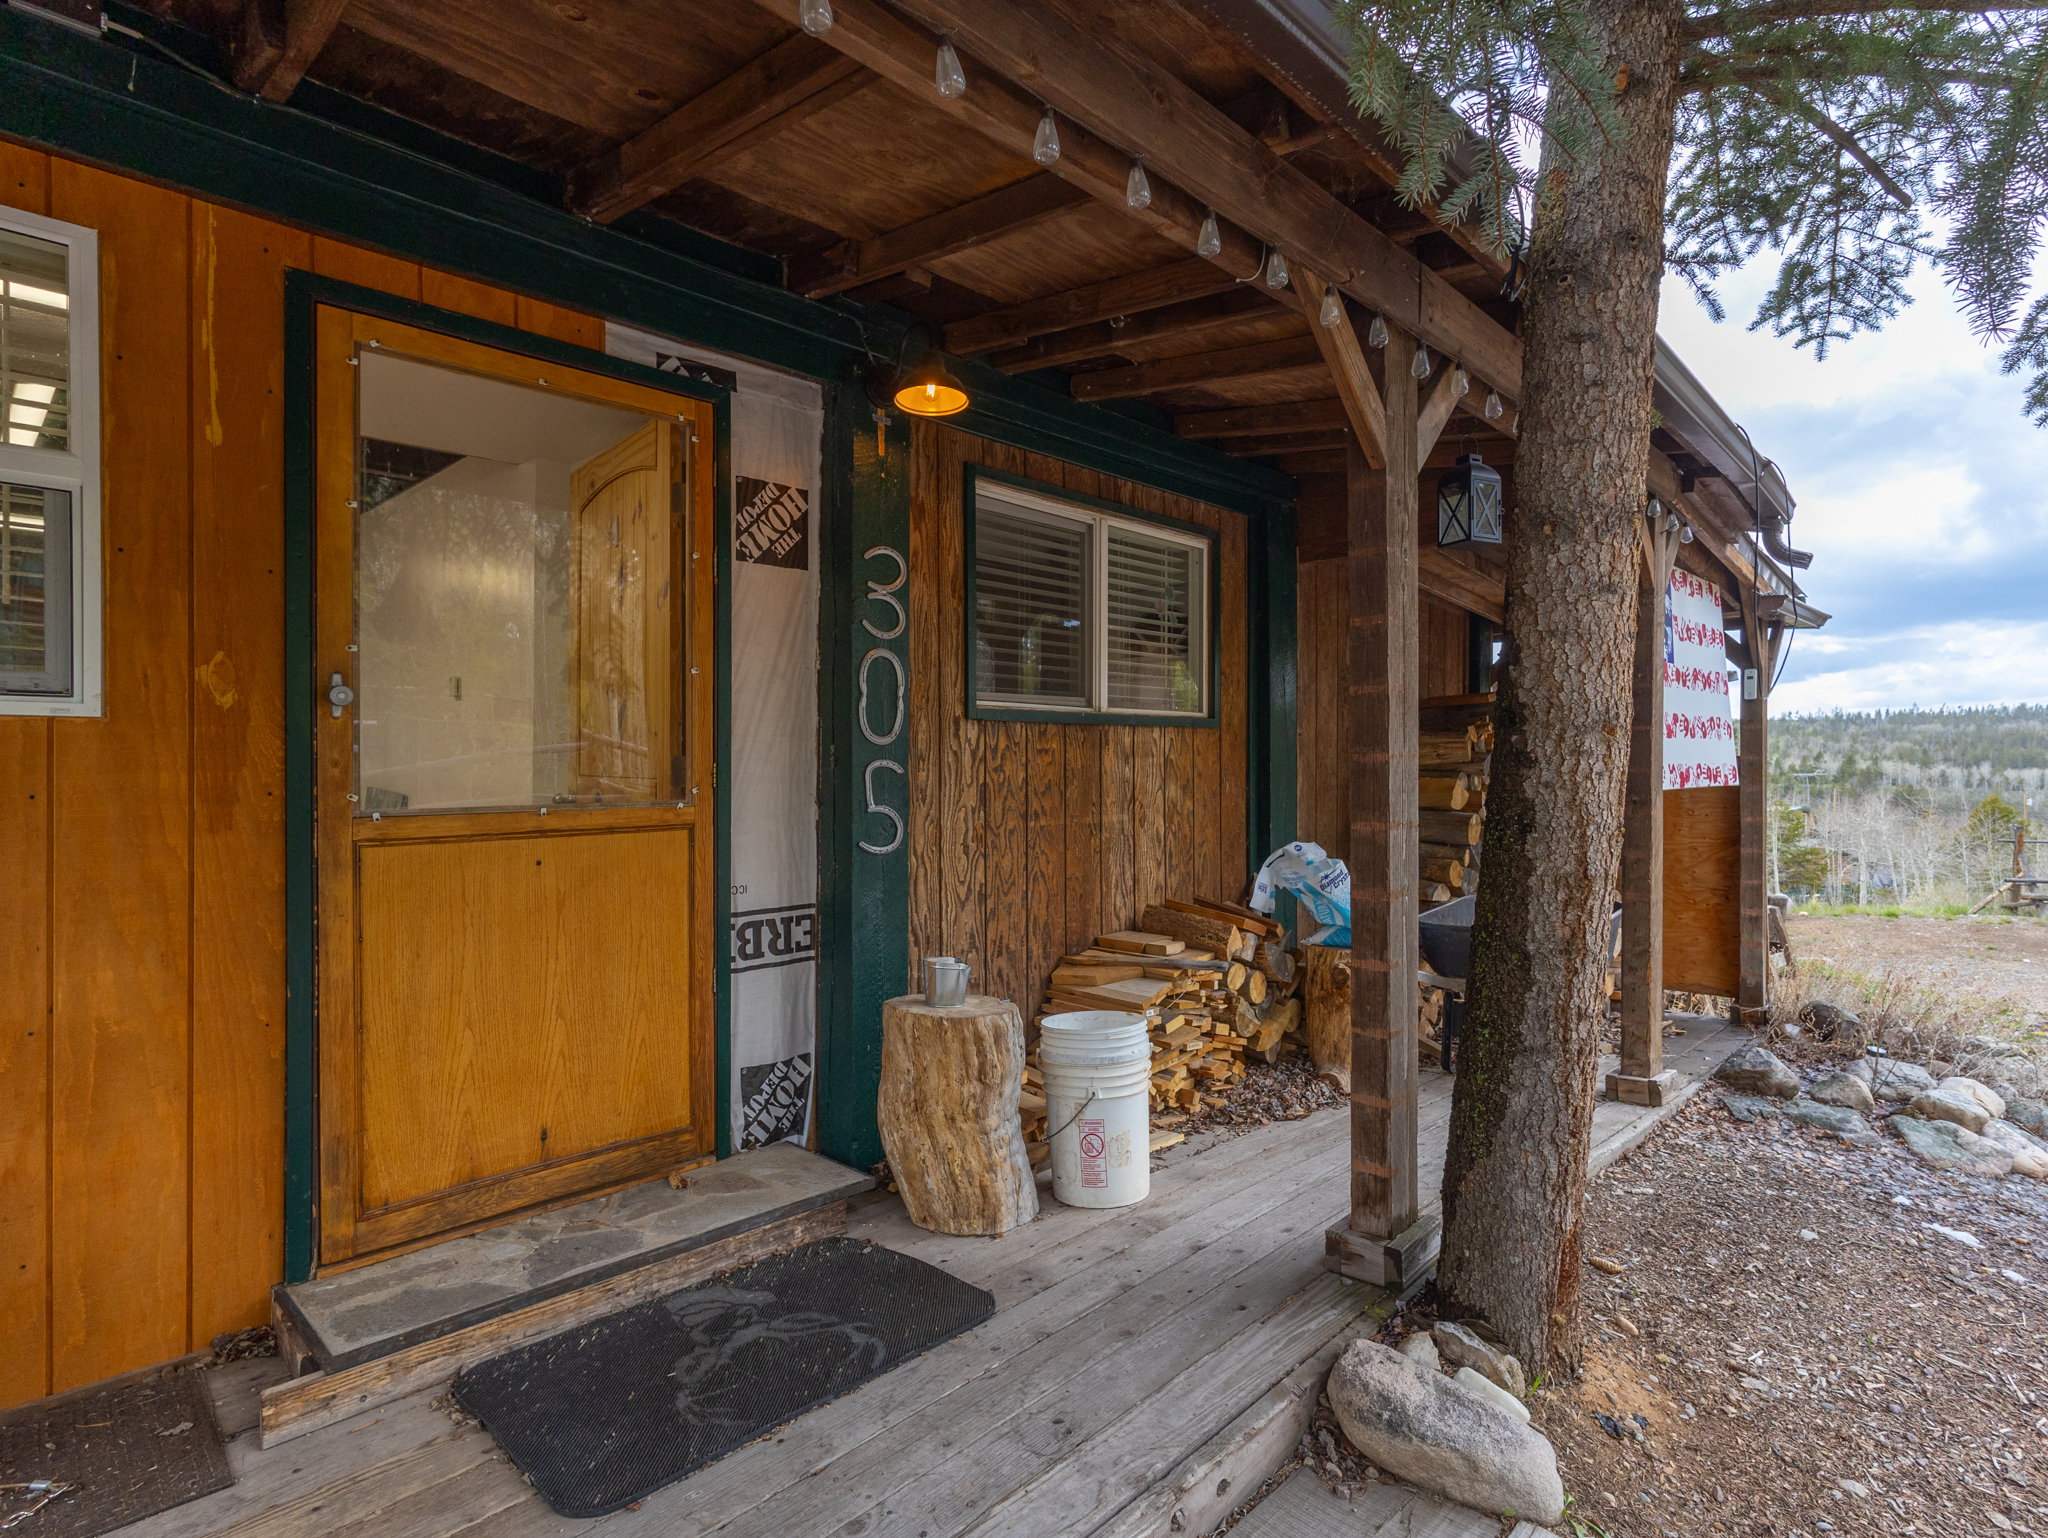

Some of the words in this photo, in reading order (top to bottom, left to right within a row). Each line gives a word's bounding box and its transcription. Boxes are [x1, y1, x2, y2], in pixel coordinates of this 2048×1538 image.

[736, 482, 781, 531] DEPOT
[736, 487, 809, 562] HOME
[771, 528, 802, 559] THE
[859, 545, 907, 854] 305
[731, 885, 748, 896] ICC
[1319, 869, 1344, 891] Diamond
[731, 913, 815, 962] ERB
[743, 1061, 788, 1122] DEPOT
[743, 1056, 811, 1146] HOME
[778, 1097, 805, 1132] THE
